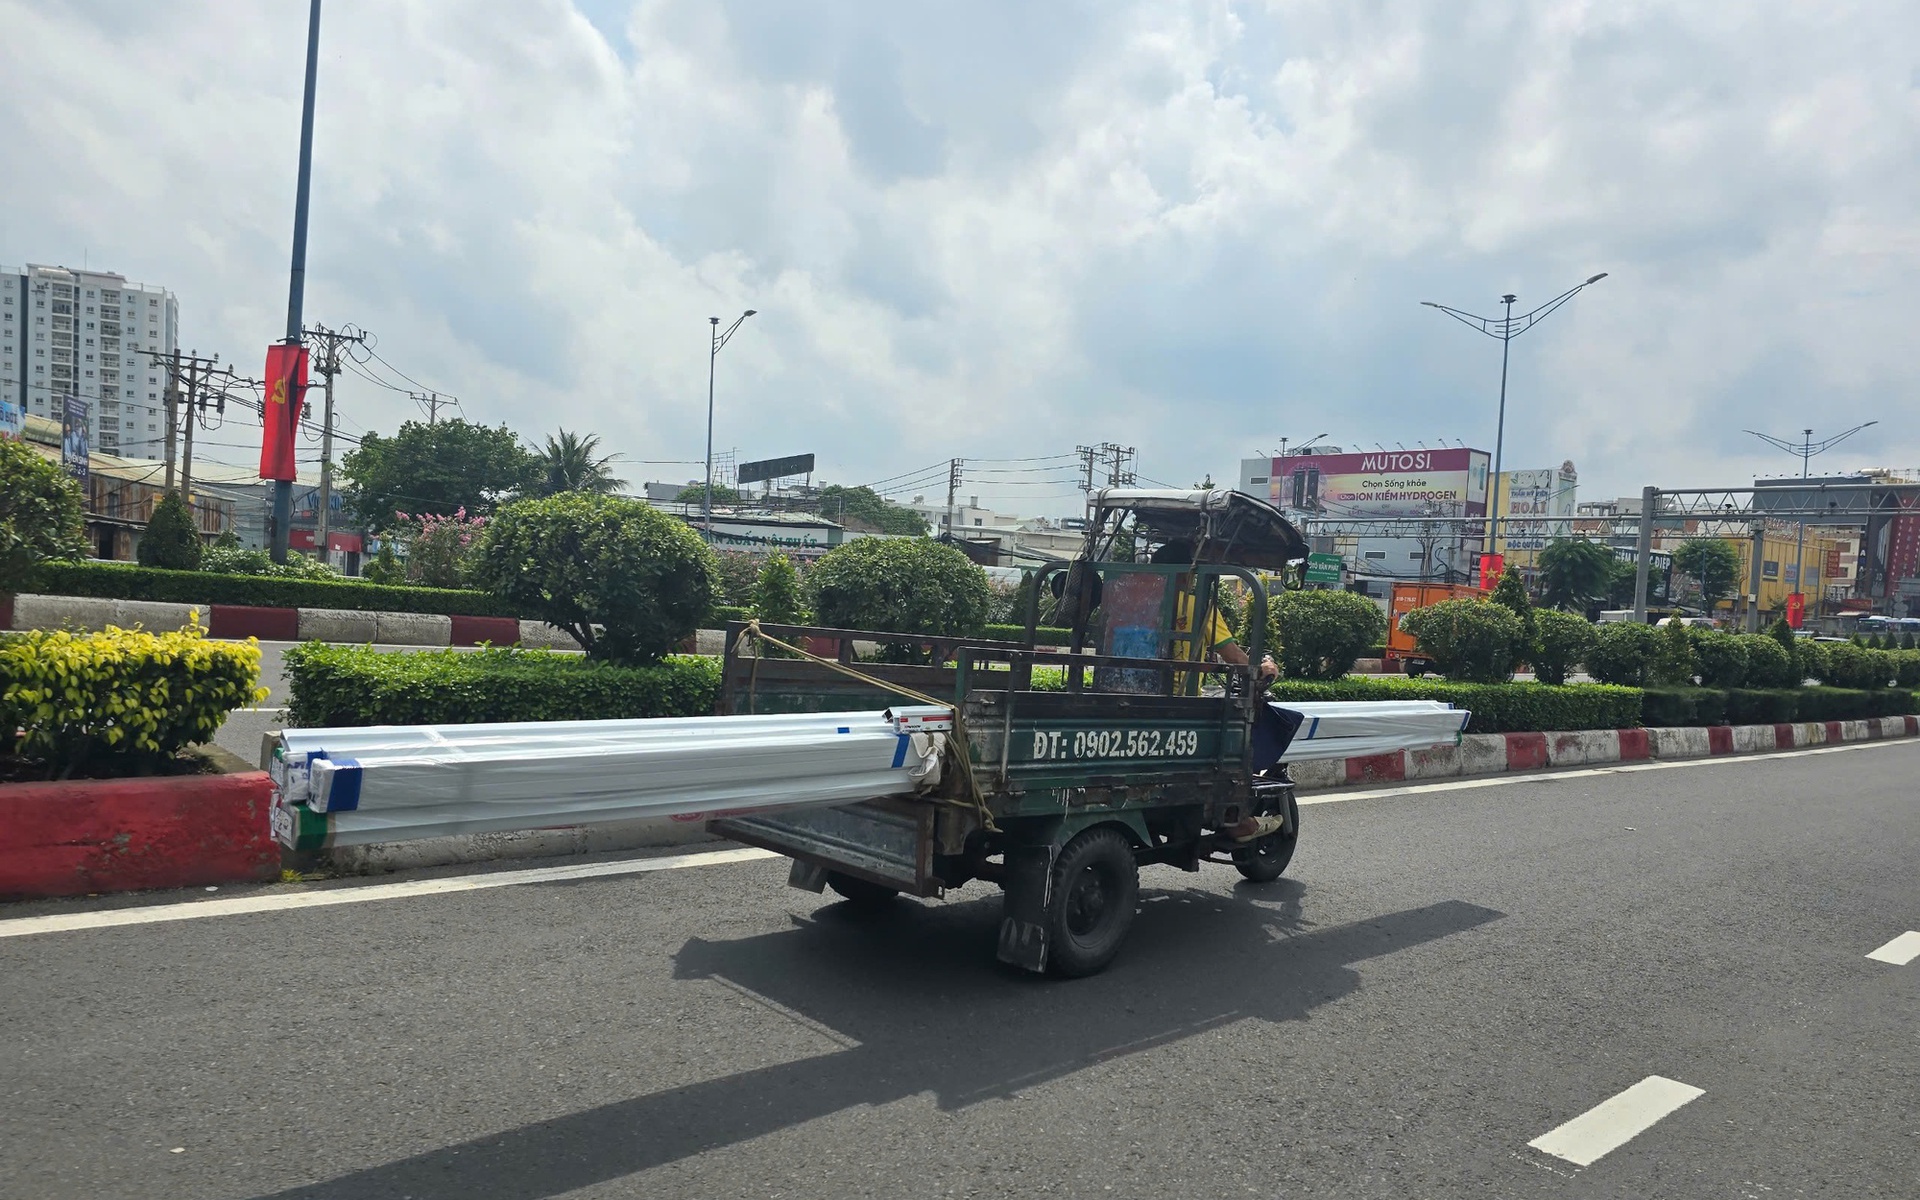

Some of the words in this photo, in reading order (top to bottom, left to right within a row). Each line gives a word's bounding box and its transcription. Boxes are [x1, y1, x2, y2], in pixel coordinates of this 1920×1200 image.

[1361, 453, 1431, 471] MUTOSI
[1362, 480, 1383, 490] Chọn
[1384, 479, 1405, 489] Sống
[1406, 479, 1427, 488] khỏe
[1399, 490, 1457, 501] HYDROGEN
[1033, 731, 1067, 759] ĐT:
[1074, 730, 1198, 759] 0902.562.459
